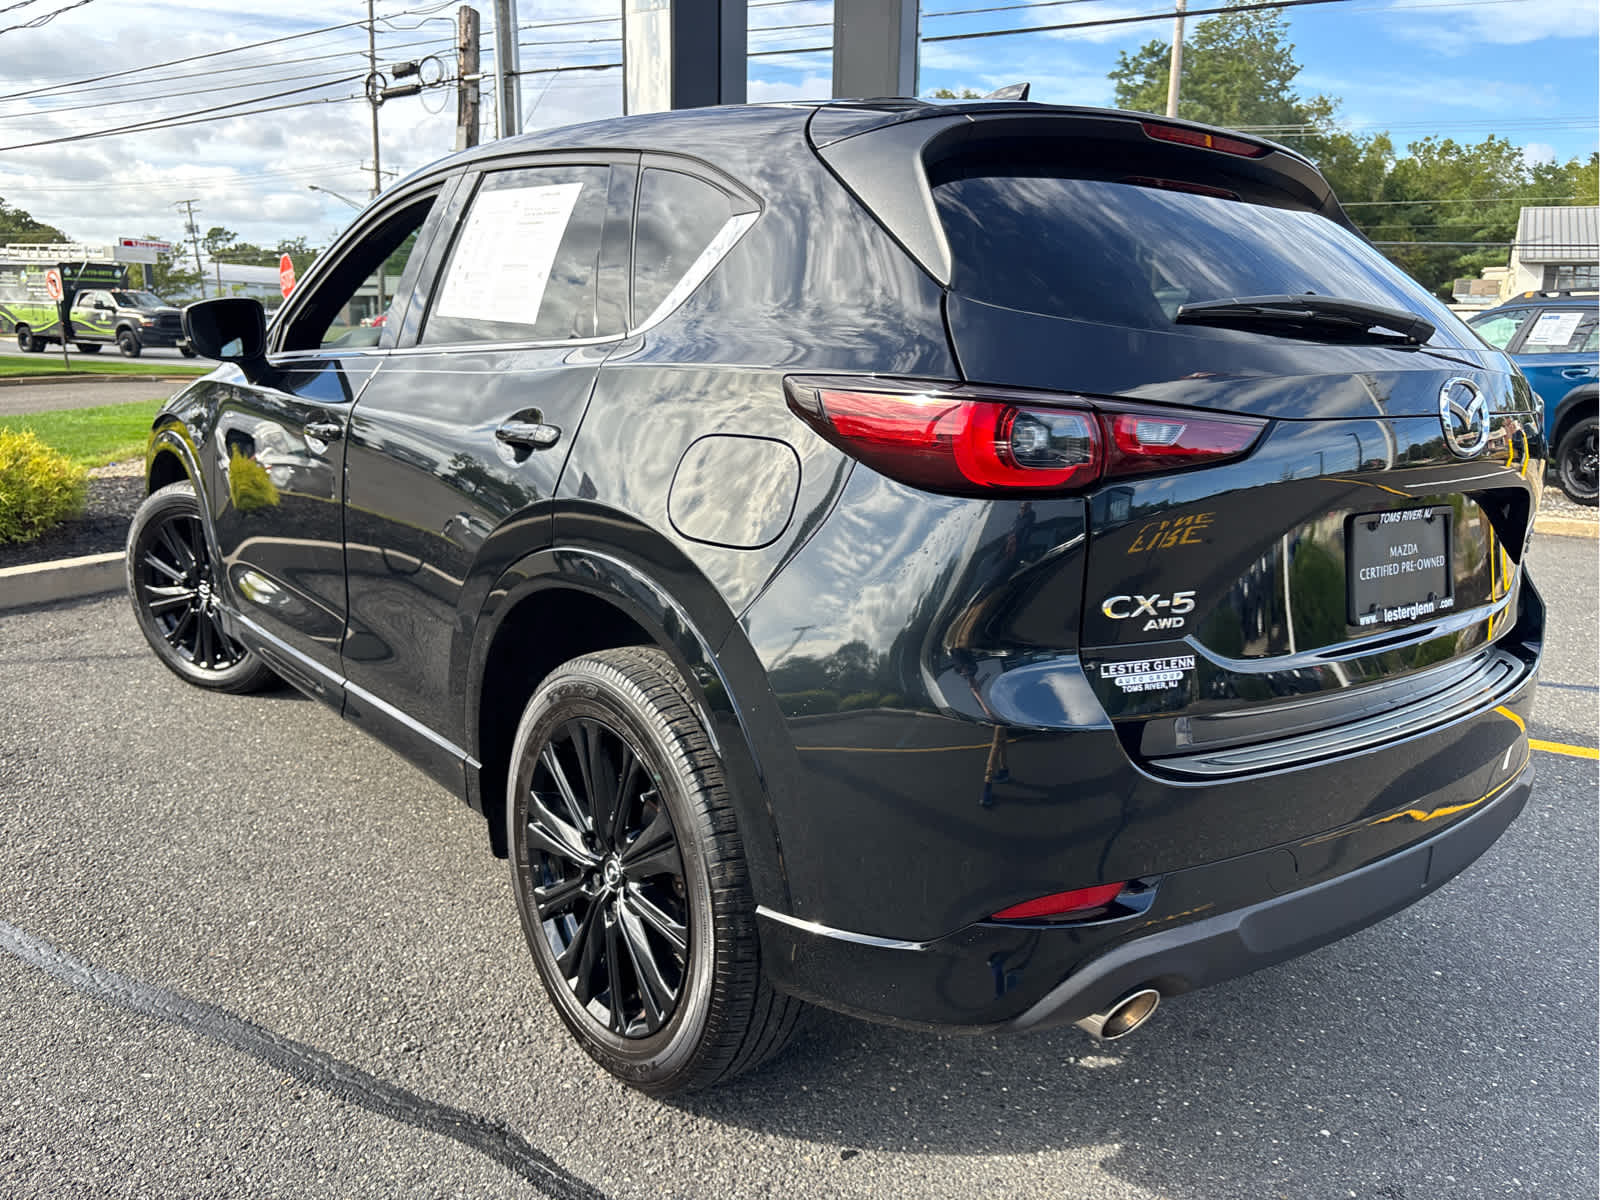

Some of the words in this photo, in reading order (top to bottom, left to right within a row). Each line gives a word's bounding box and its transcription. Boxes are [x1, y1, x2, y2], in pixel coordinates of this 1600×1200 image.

[1380, 512, 1400, 524] TOMS
[1389, 543, 1418, 557] MAZDA
[1360, 563, 1399, 580] CERTIFIED
[1401, 555, 1445, 573] PRE-OWNED
[1102, 591, 1197, 619] CX-5
[1384, 601, 1434, 622] lesterglenn
[1143, 617, 1185, 631] AWD
[1101, 662, 1151, 676] LESTER
[1153, 656, 1195, 671] GLENN
[1118, 675, 1145, 685] AUTO
[1148, 671, 1182, 682] GROUP
[1122, 683, 1143, 693] TOMS
[1169, 680, 1178, 688] NJ
